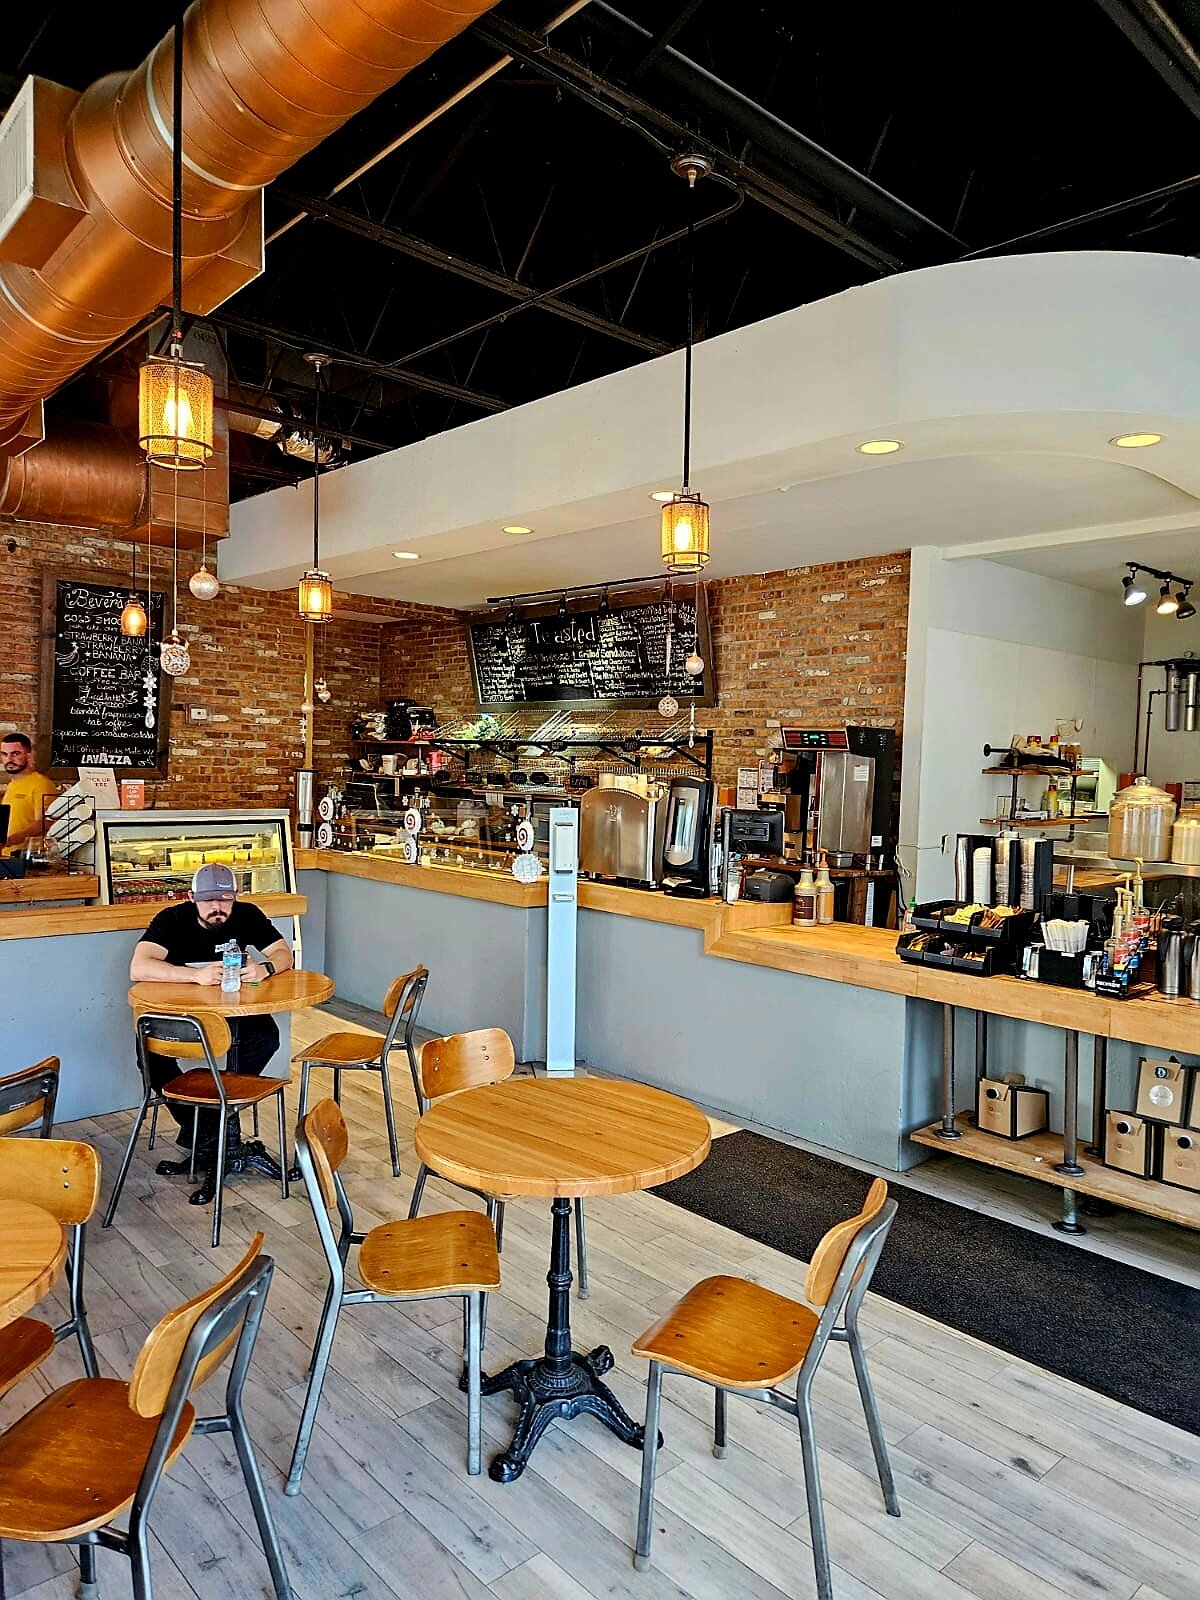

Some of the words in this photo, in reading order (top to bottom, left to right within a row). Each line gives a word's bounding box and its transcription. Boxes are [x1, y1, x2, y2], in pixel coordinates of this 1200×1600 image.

[64, 631, 118, 643] STRAWBERRY
[80, 641, 145, 654] STRAWBERRY
[92, 650, 132, 661] BANANA
[70, 666, 116, 678] COFFEE
[119, 669, 142, 680] BAR
[81, 753, 132, 765] LAVAZZA
